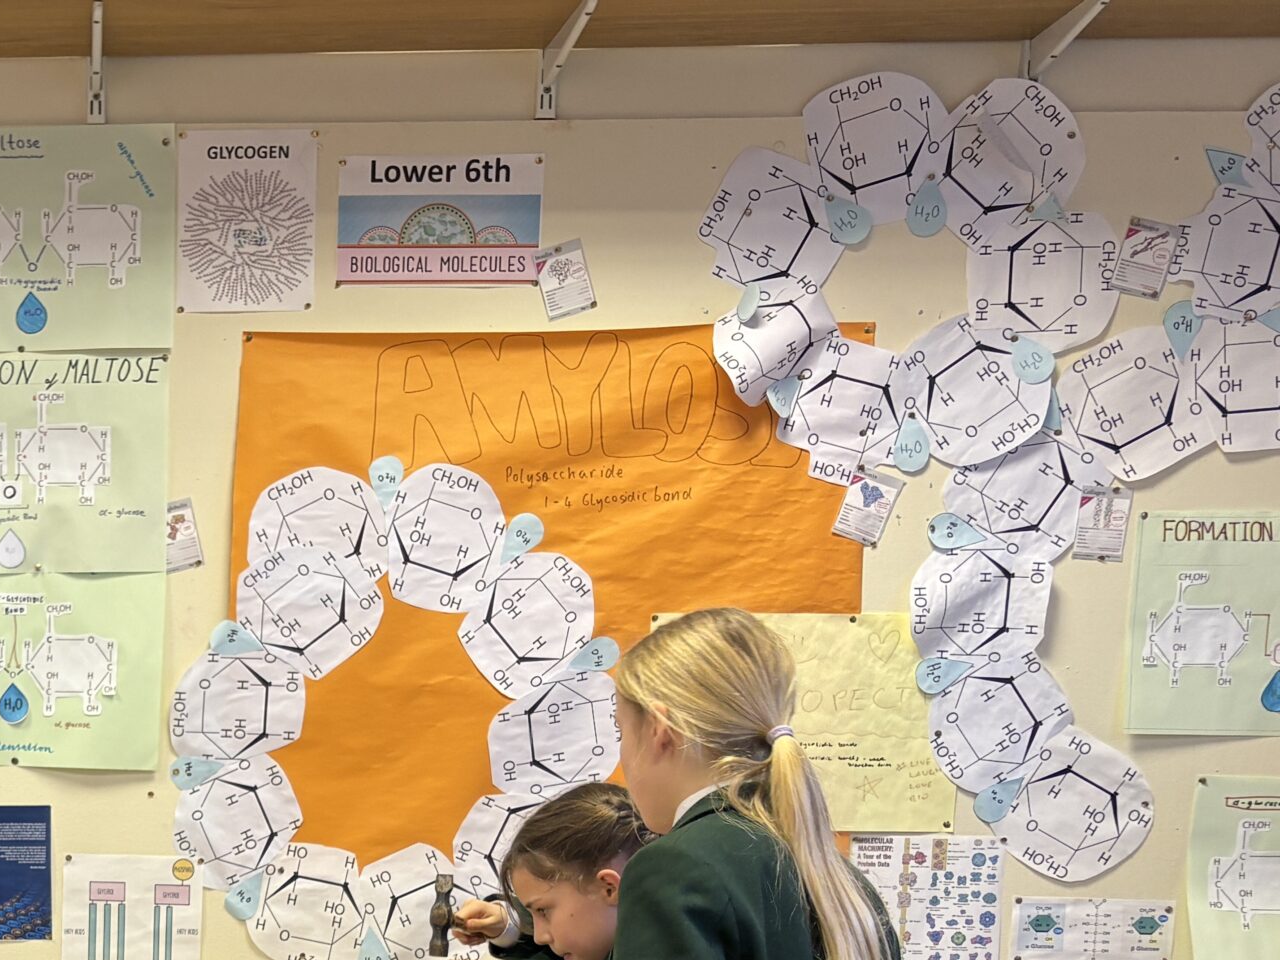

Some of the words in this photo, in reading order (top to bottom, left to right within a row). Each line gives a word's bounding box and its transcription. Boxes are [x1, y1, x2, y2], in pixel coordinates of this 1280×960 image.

[207, 145, 289, 160] GLYCOGEN
[370, 160, 456, 183] Lower
[465, 158, 511, 183] 6th
[834, 211, 858, 232] H2O
[914, 205, 940, 219] H2O
[349, 256, 432, 274] BIOLOGICAL
[440, 255, 526, 273] MOLECULES
[62, 357, 163, 384] MALTOSE
[900, 443, 922, 457] H2O
[506, 465, 624, 485] Polysaccharide
[582, 492, 648, 511] Glycosidic
[654, 486, 692, 504] bond
[1163, 520, 1273, 542] FORMATION
[3, 698, 23, 713] H2O
